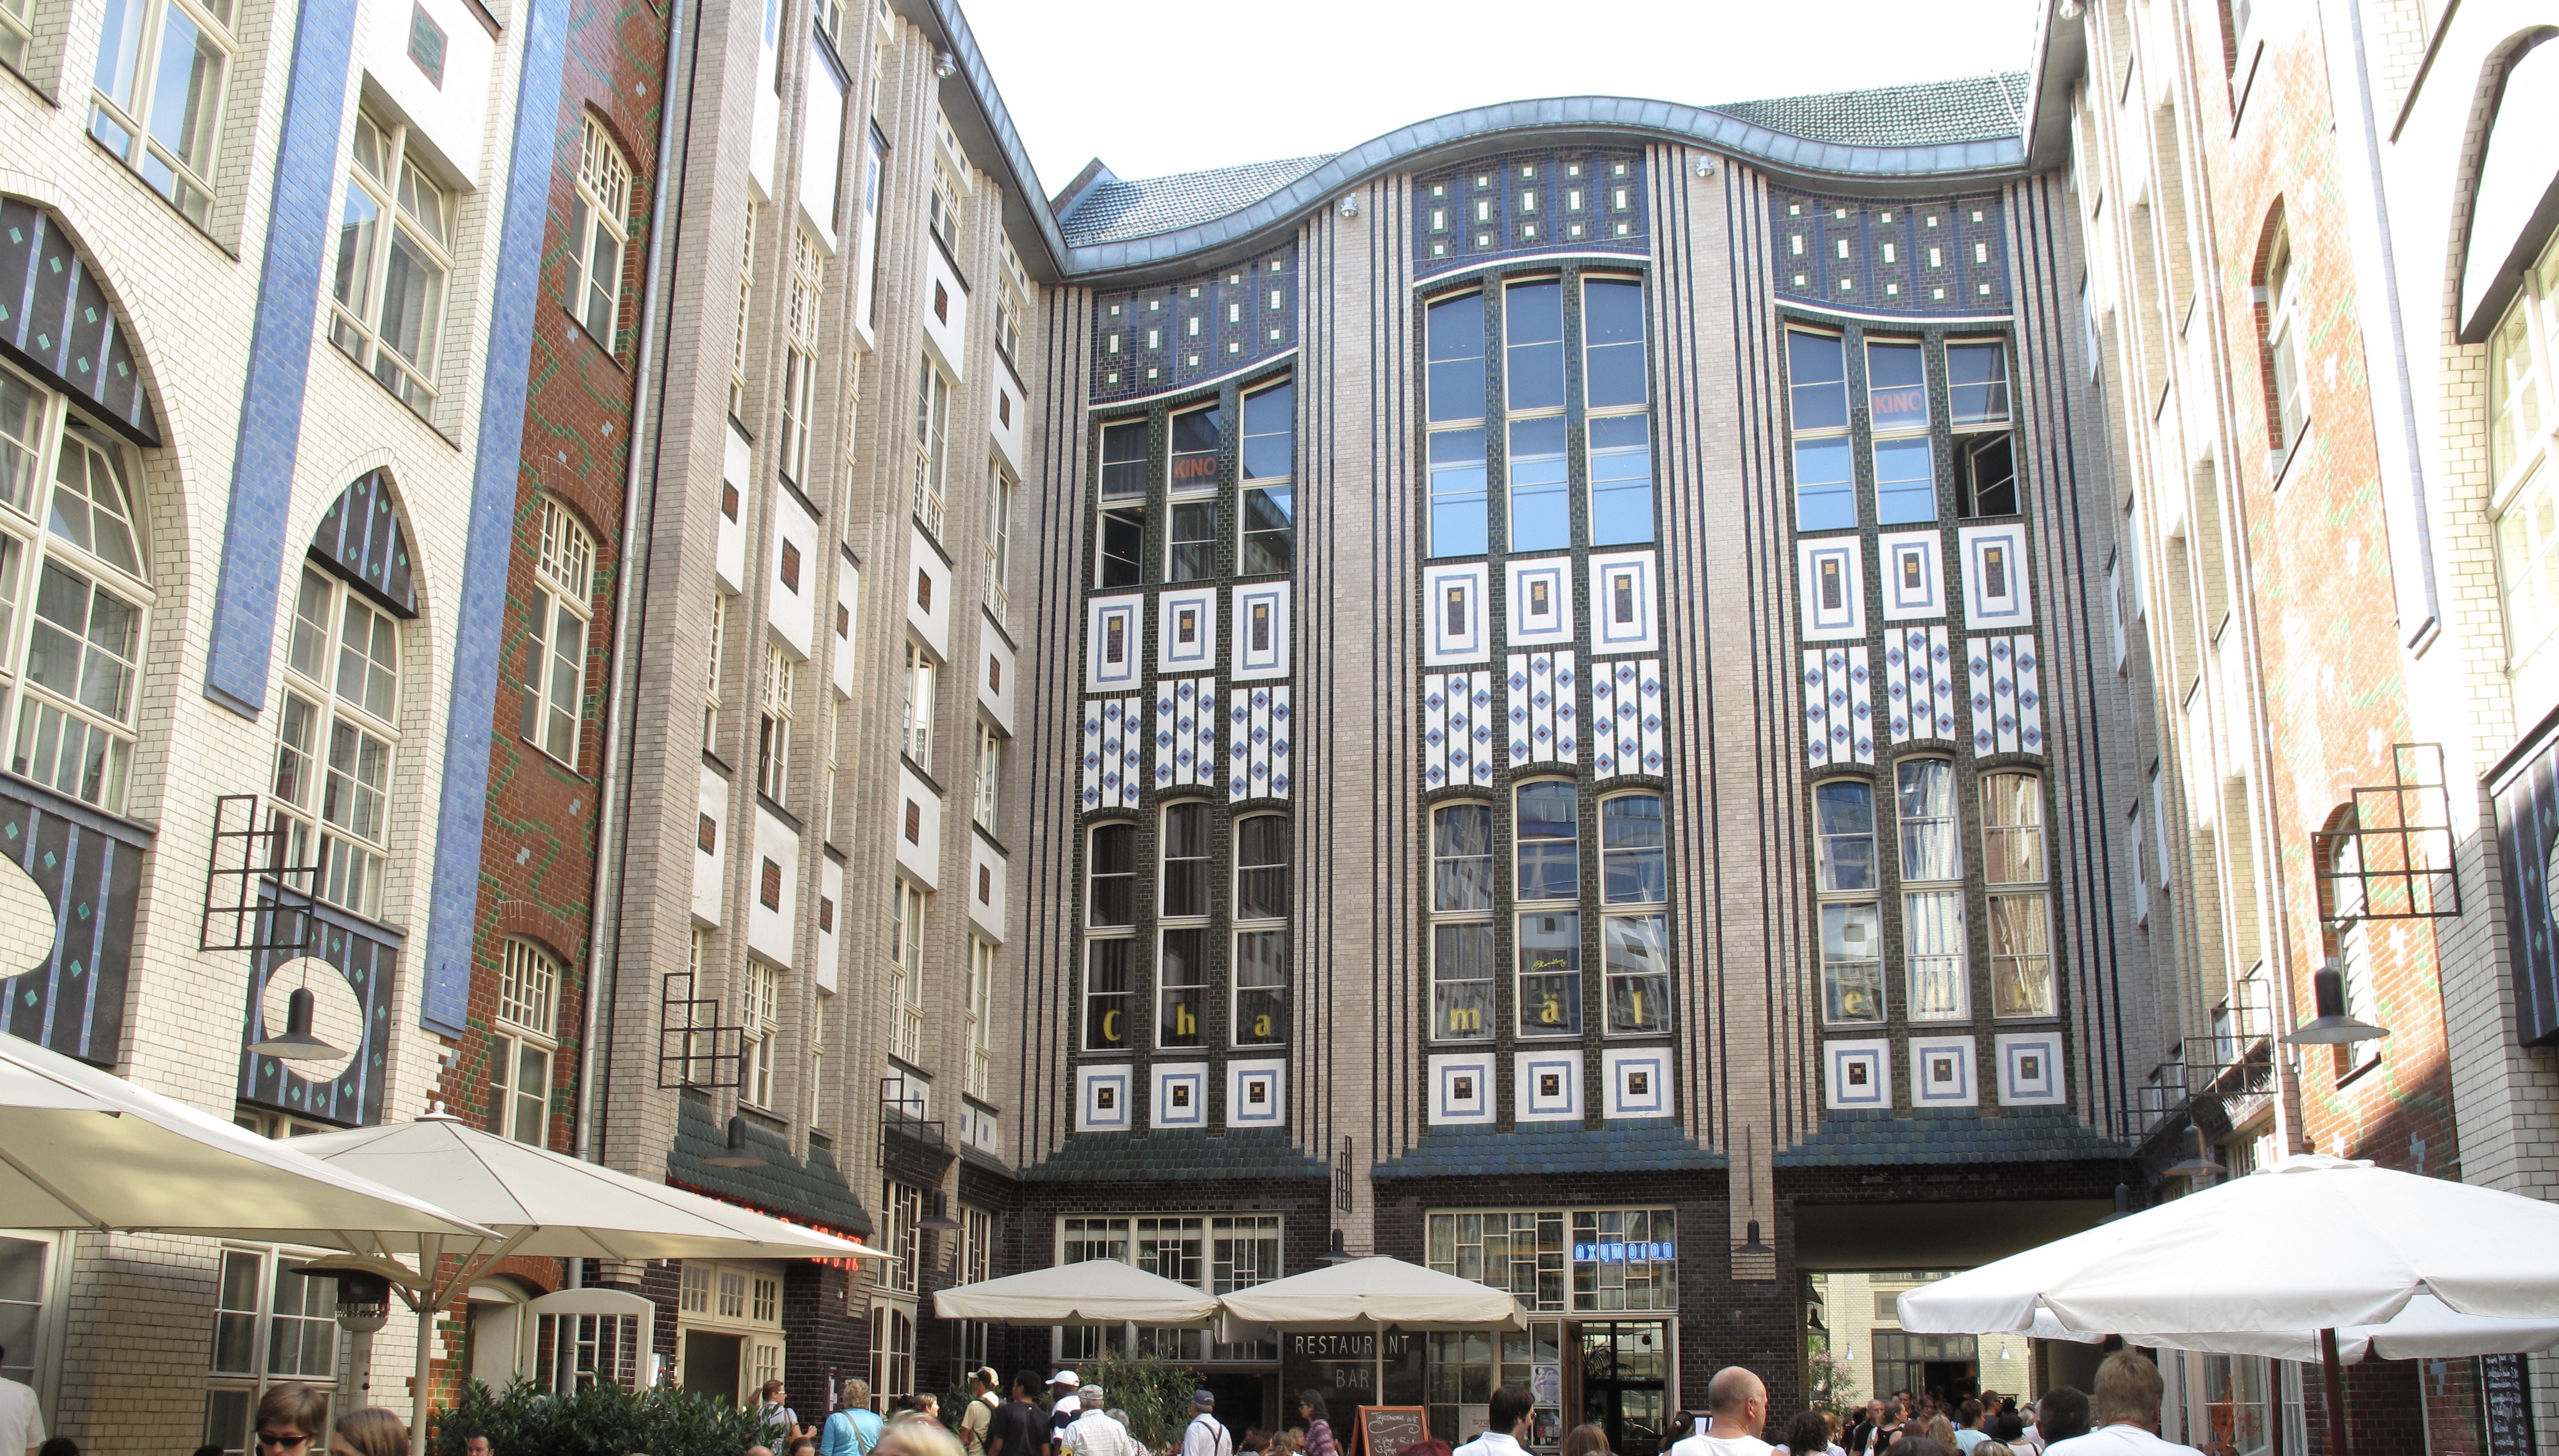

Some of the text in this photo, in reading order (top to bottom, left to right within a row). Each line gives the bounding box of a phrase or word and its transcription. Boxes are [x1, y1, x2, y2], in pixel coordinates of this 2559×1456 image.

[1875, 392, 1923, 414] KINO
[1174, 457, 1217, 479] KINO
[1576, 1242, 1672, 1262] oxymoron
[1295, 1335, 1409, 1355] RESTAURNT
[1336, 1369, 1369, 1388] BAR
